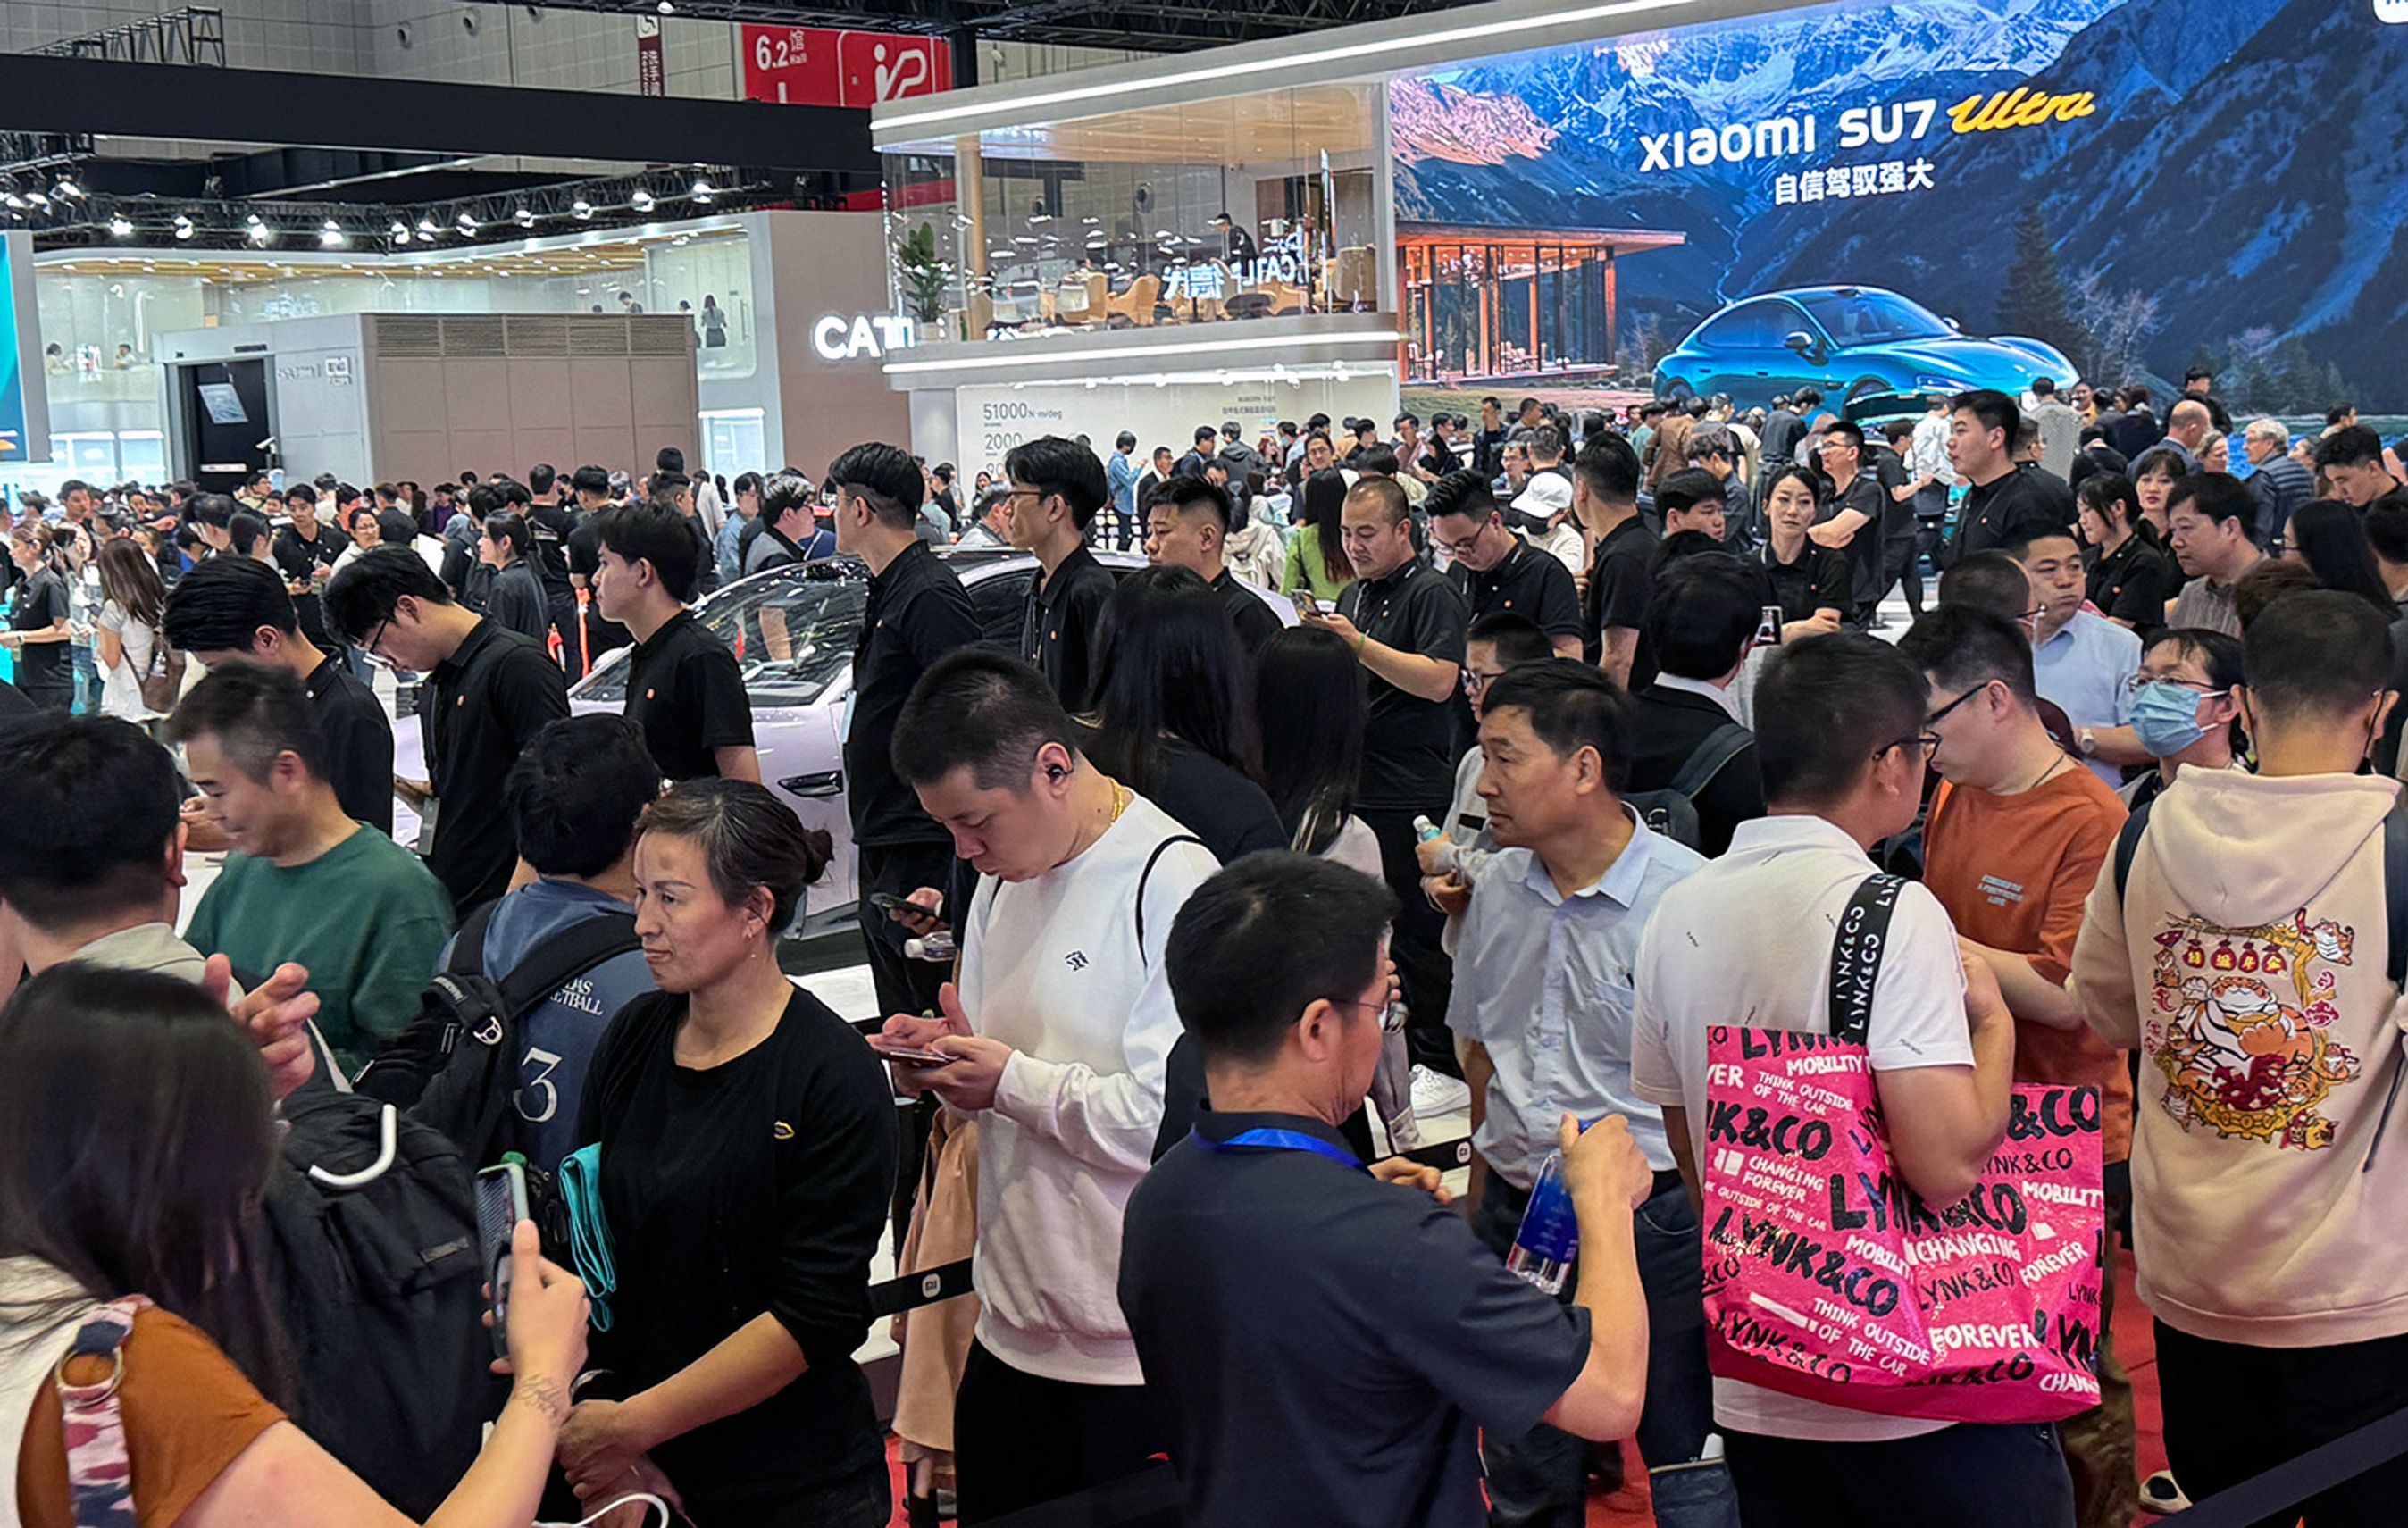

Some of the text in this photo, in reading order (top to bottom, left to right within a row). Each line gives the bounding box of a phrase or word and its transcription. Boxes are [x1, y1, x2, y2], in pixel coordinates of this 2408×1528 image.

[756, 35, 789, 71] 6.2
[1839, 98, 1936, 148] SU7
[1947, 87, 2095, 135] Ultra
[1774, 158, 1935, 205] 自信驾驭强大
[983, 403, 1027, 420] 51000
[984, 432, 1023, 451] 2000
[513, 1047, 563, 1123] 3
[1786, 1055, 1863, 1077] MOBILITY
[1752, 1083, 1827, 1116] OF THE CAR
[1758, 1071, 1854, 1111] THINK OUTSIDE
[1742, 1171, 1807, 1204] FOREVER
[1748, 1155, 1826, 1193] CHANGING
[1718, 1186, 1764, 1210] OUTSIDE
[1766, 1202, 1783, 1215] OF
[1786, 1207, 1805, 1224] THE
[1807, 1216, 1827, 1232] CAR
[1915, 1232, 2022, 1264] CHANGING
[2019, 1241, 2089, 1287] FOREVER
[1814, 1297, 1931, 1365] THINK OUTSIDE
[1819, 1323, 1908, 1378] OF THE CAR
